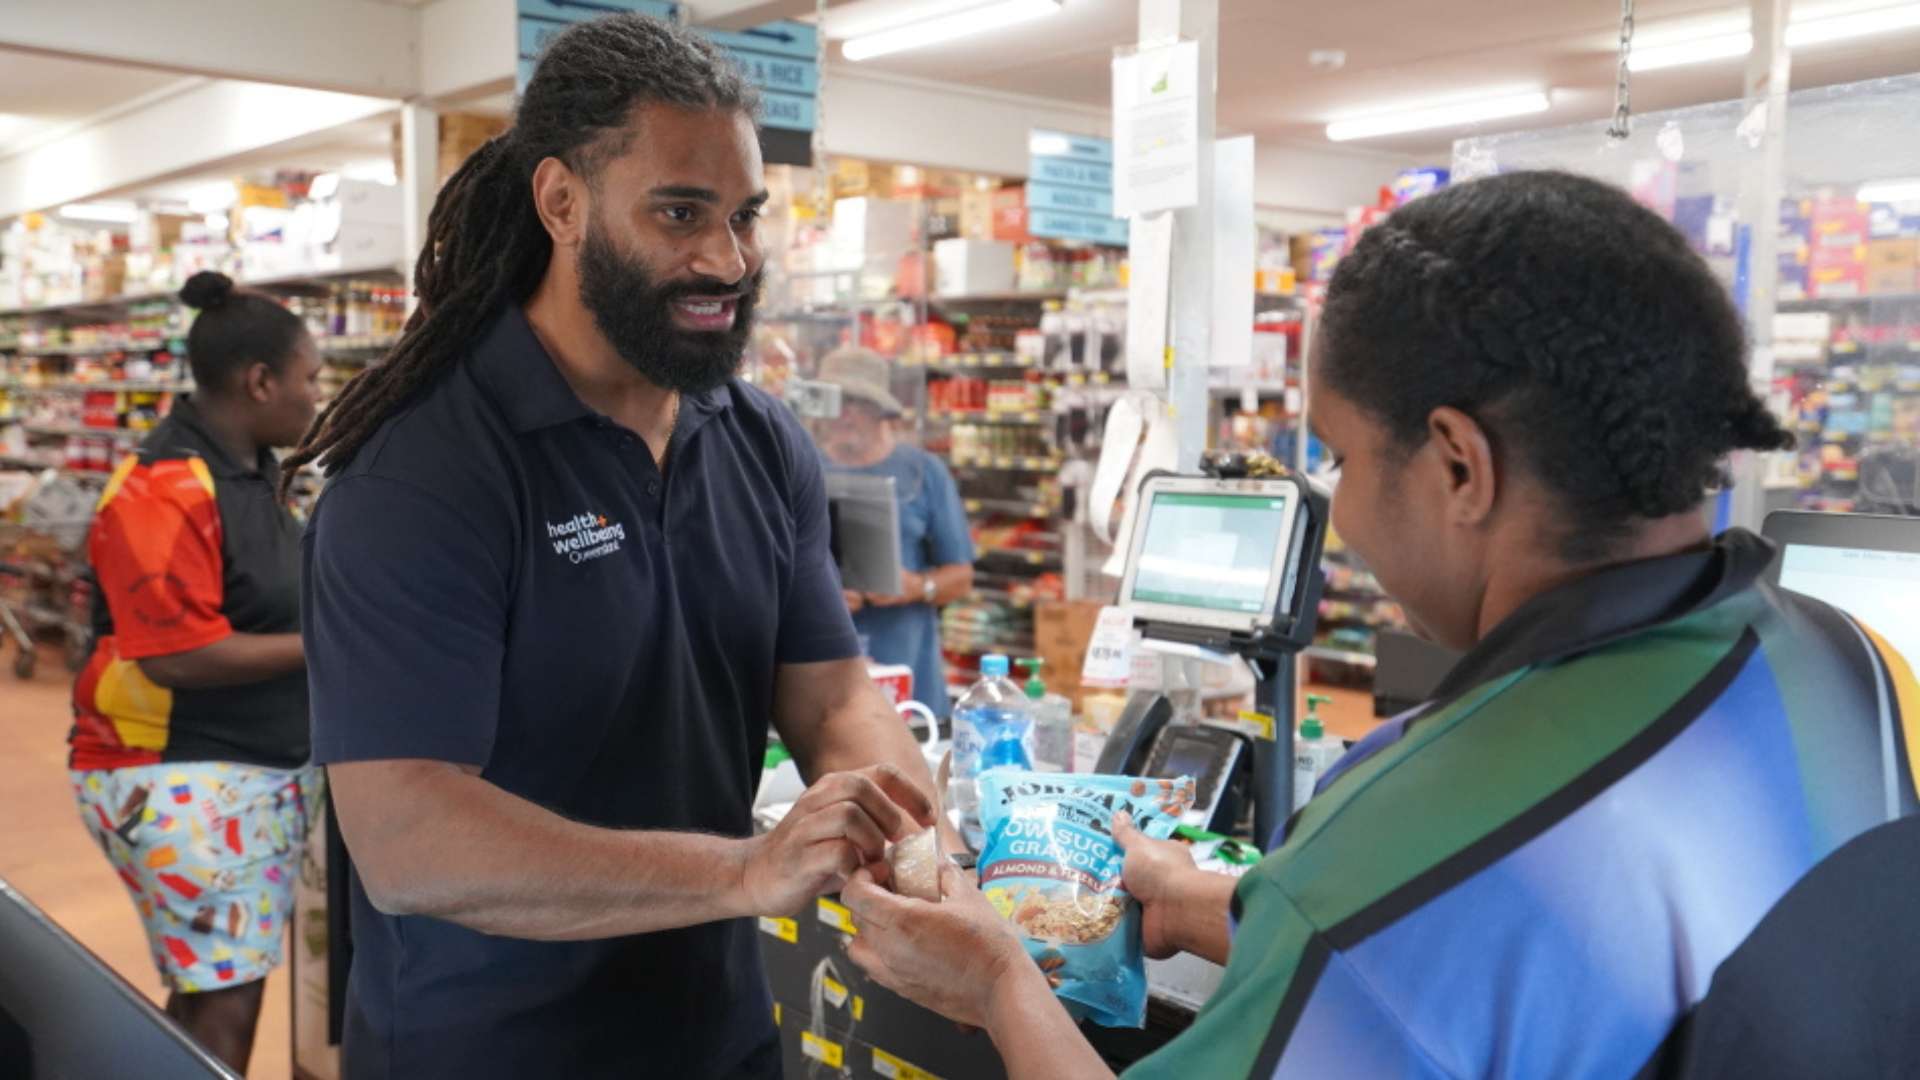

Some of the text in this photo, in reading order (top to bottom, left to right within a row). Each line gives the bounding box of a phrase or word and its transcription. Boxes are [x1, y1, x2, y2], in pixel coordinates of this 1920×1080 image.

[552, 522, 625, 554] wellbeing
[1001, 817, 1049, 839] OW
[991, 863, 1047, 877] ALMOND
[1009, 839, 1112, 880] GRANOLA
